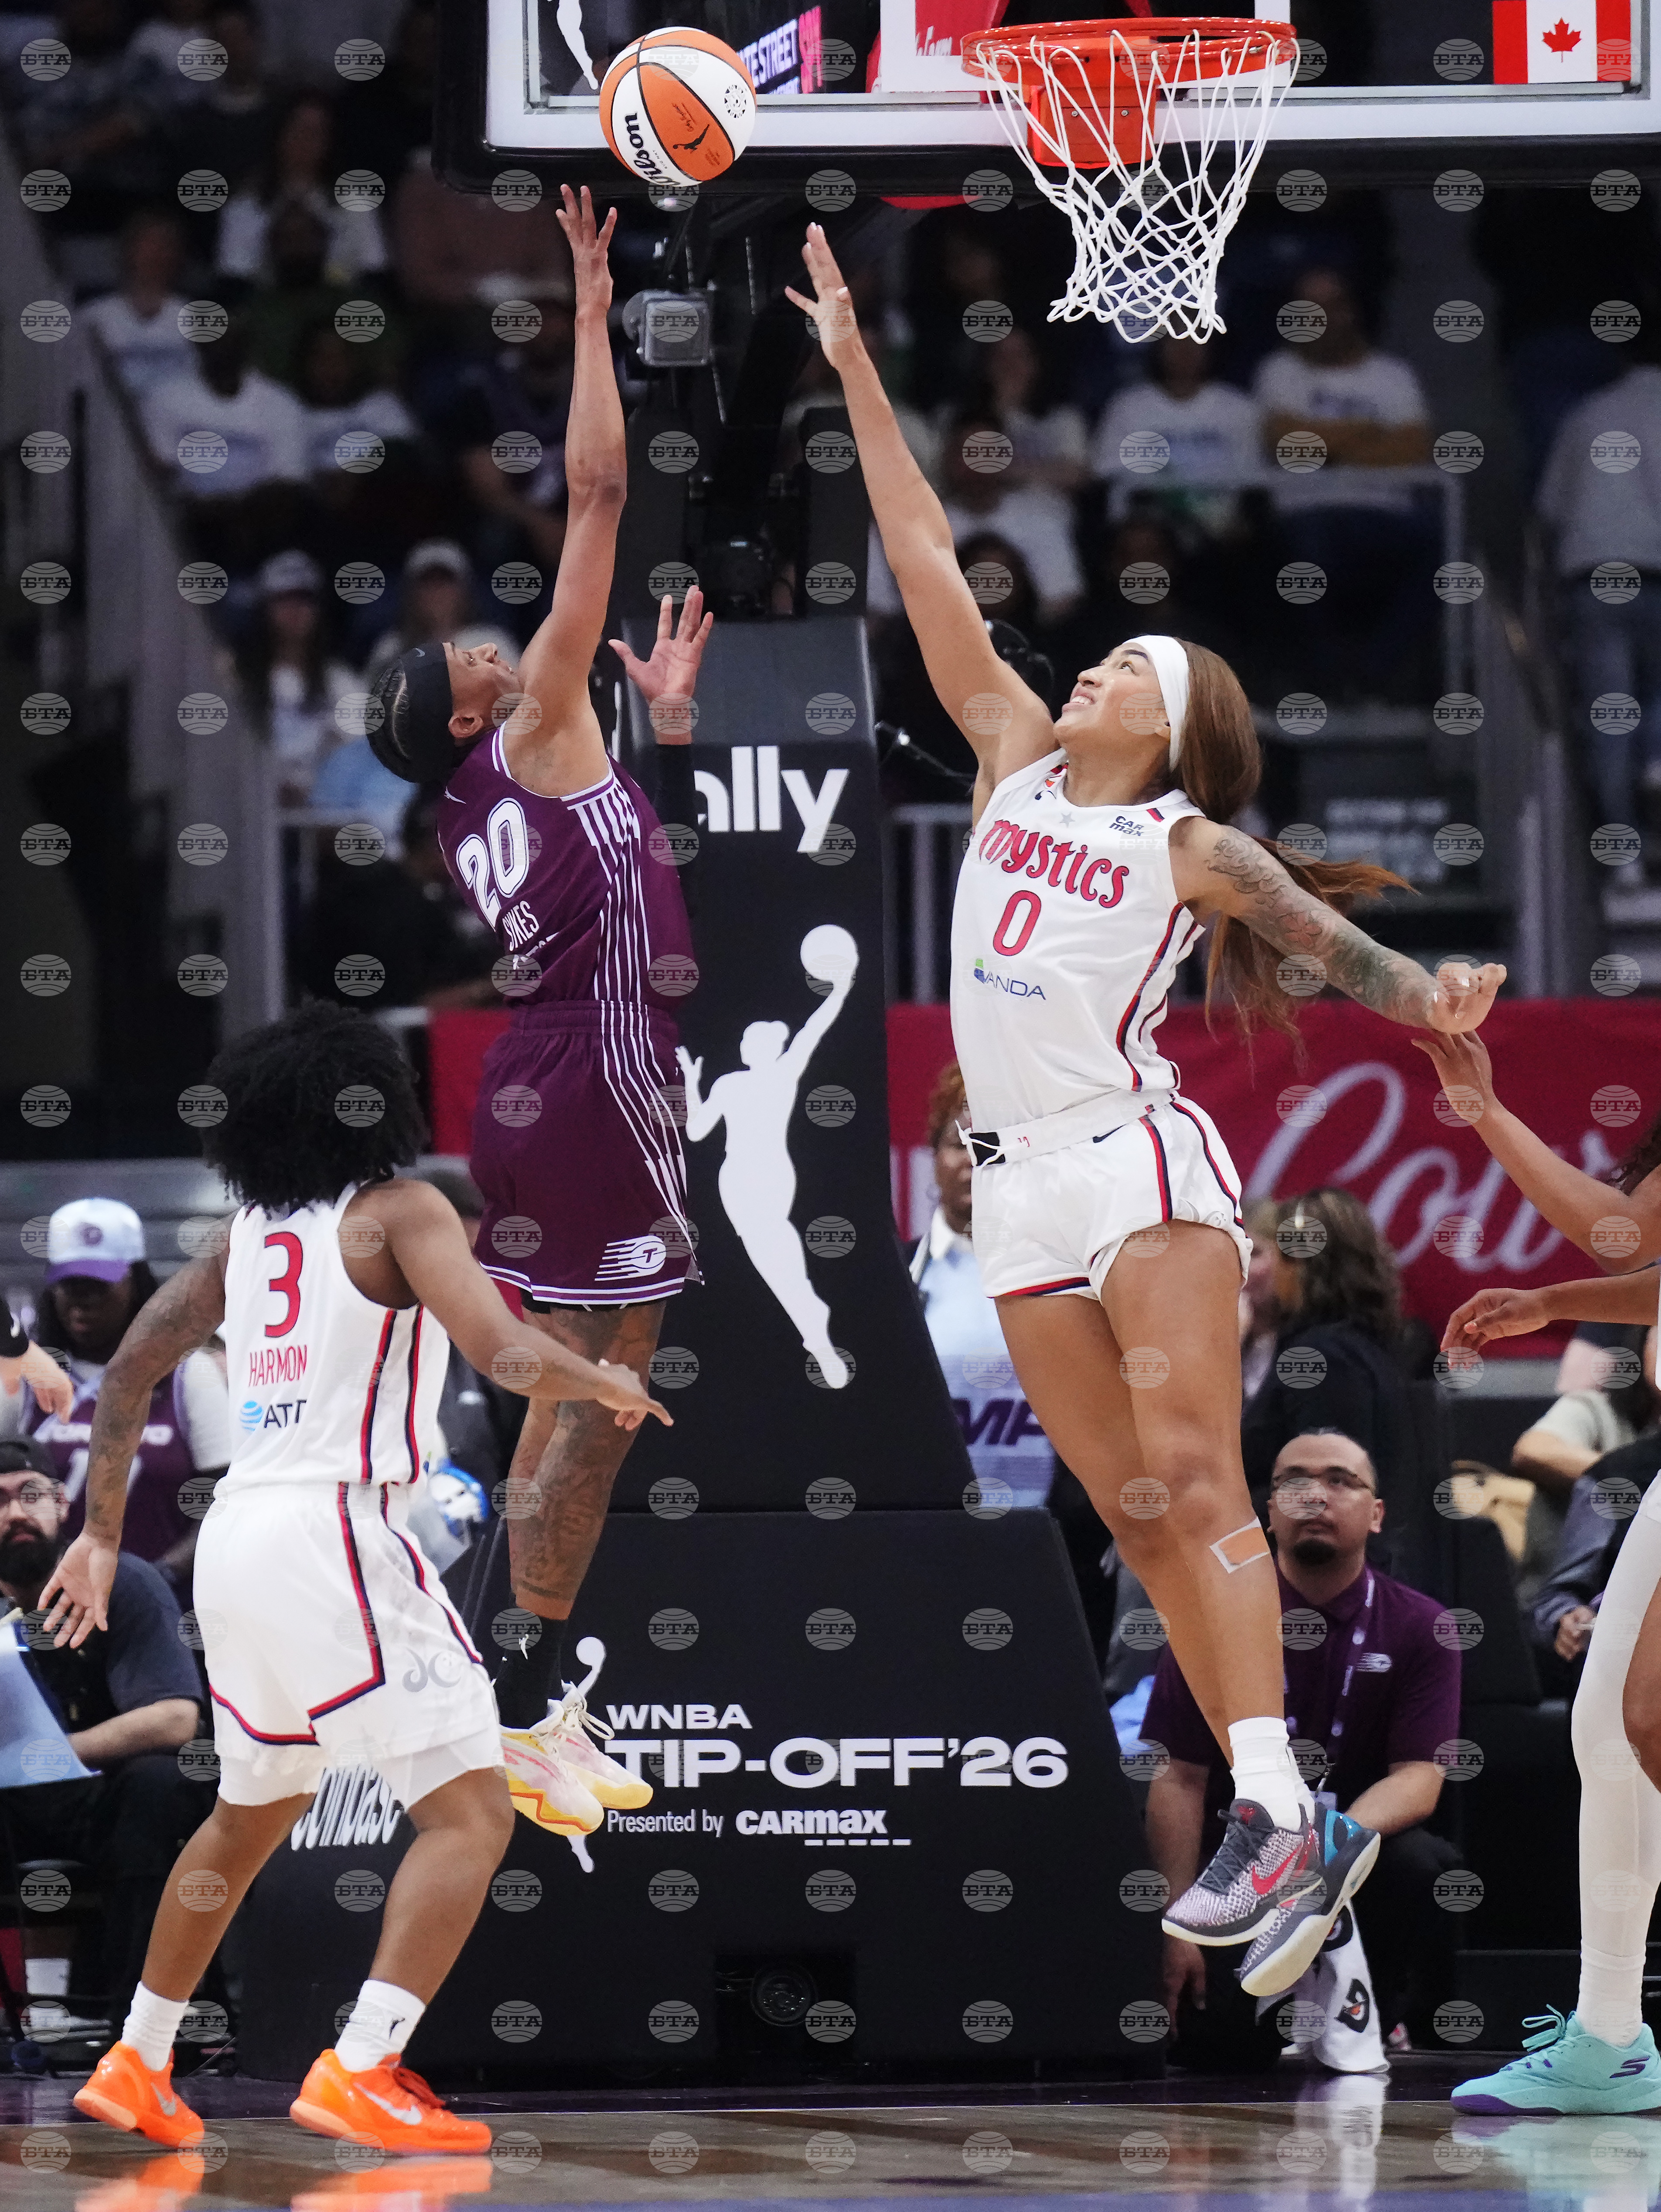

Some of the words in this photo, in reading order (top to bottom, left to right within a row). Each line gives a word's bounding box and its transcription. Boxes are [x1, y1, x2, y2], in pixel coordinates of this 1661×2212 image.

[456, 797, 529, 932] 20
[993, 890, 1042, 956] 0
[264, 1231, 304, 1338] 3
[248, 1344, 307, 1387] HARMON
[606, 1704, 753, 1729] WNBA
[607, 1809, 696, 1832] Presented
[703, 1809, 724, 1838] by
